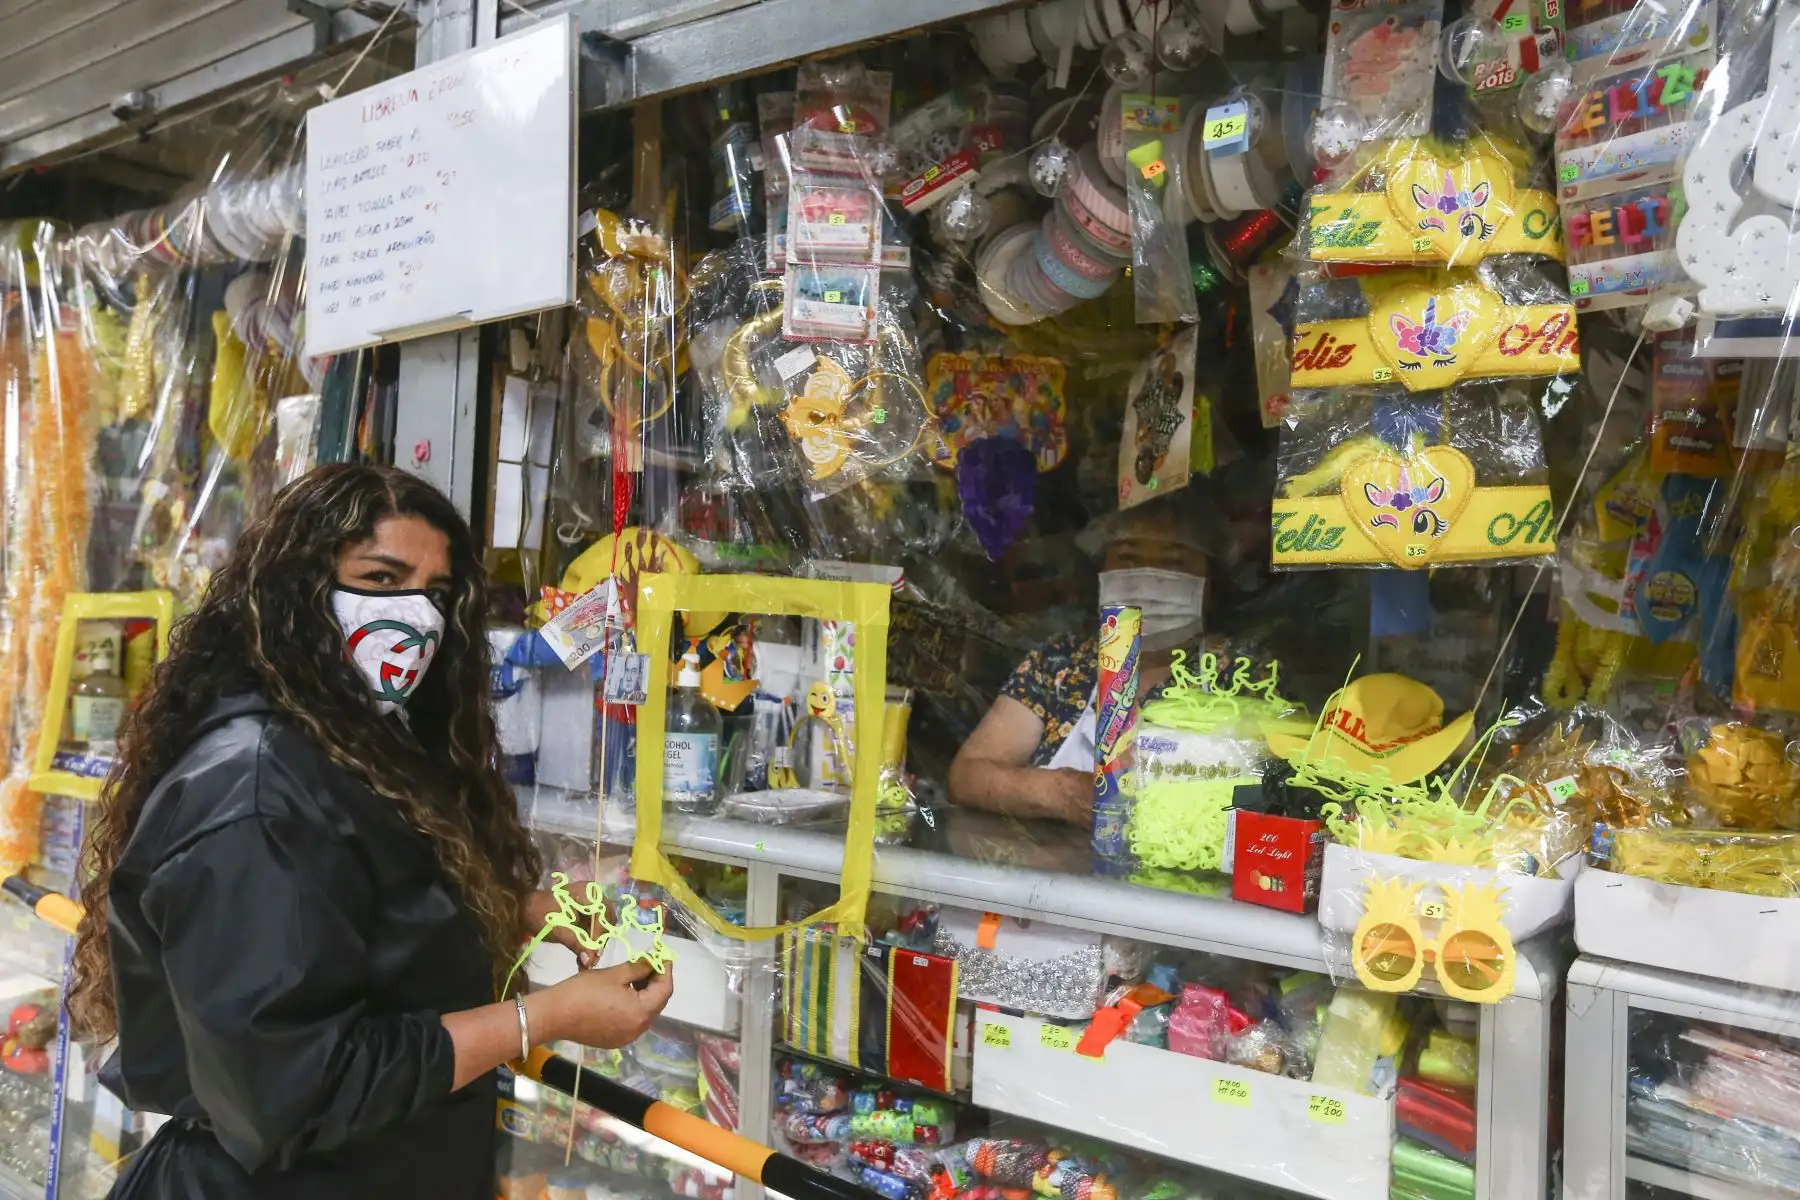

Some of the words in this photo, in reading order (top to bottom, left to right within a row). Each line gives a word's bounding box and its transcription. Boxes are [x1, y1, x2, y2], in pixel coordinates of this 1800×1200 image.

[1475, 69, 1517, 91] 2018
[569, 642, 591, 661] 200
[666, 750, 681, 760] GEL
[1259, 833, 1279, 844] 200
[1245, 844, 1265, 855] Led
[1266, 847, 1294, 861] Light
